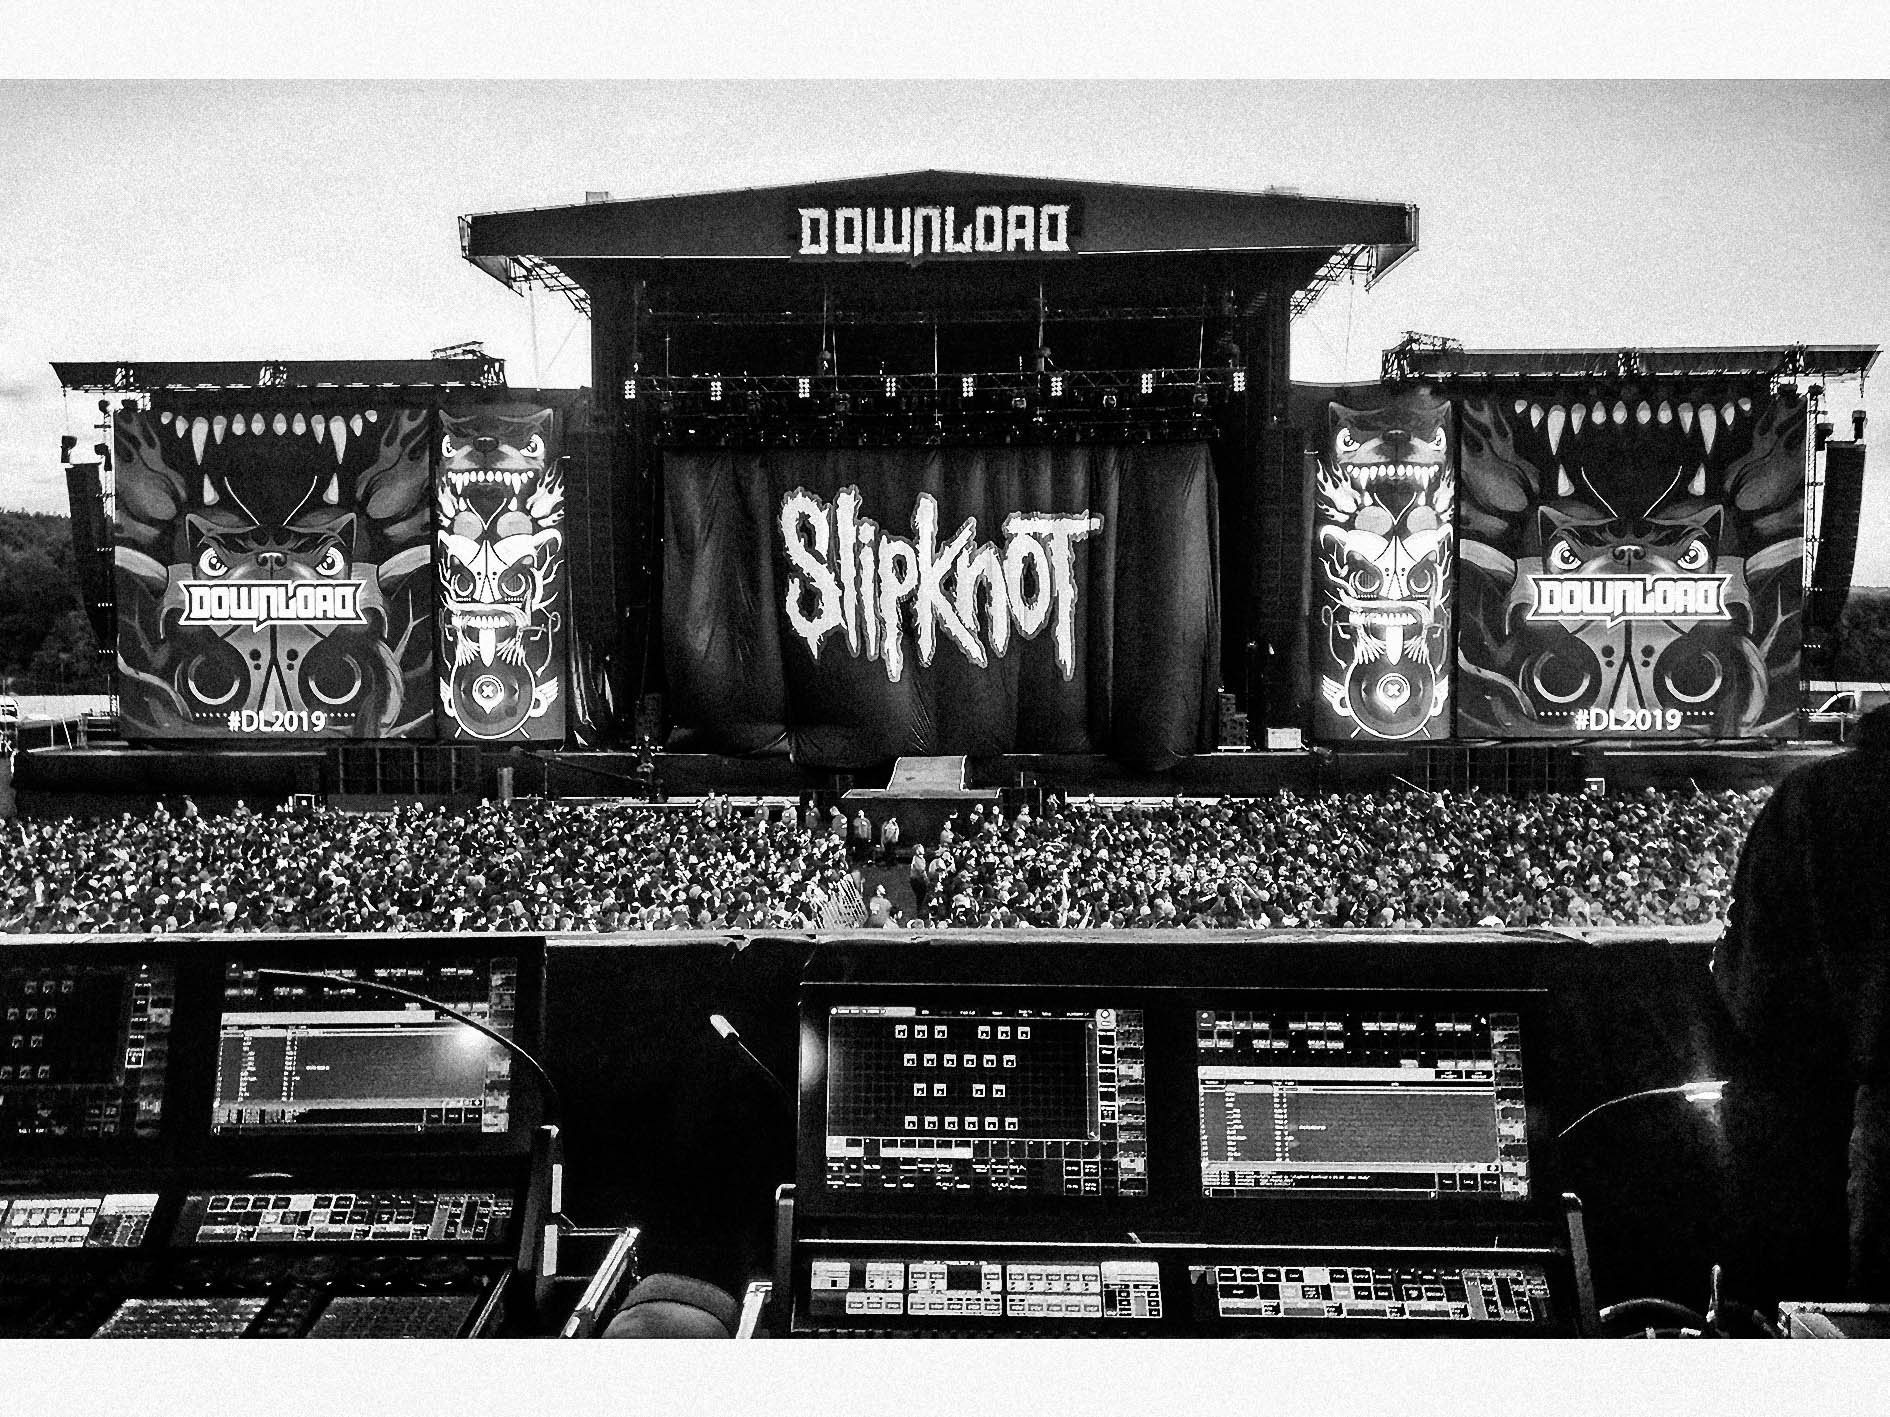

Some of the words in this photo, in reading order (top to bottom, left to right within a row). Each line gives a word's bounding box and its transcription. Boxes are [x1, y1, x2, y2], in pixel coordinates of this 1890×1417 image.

[798, 204, 1070, 257] DOWNLOAD
[188, 586, 357, 621] DOWNLOAD
[1537, 580, 1721, 616] DOWNLOAD
[227, 709, 326, 733] #DL2019
[1574, 707, 1682, 731] #DL2019
